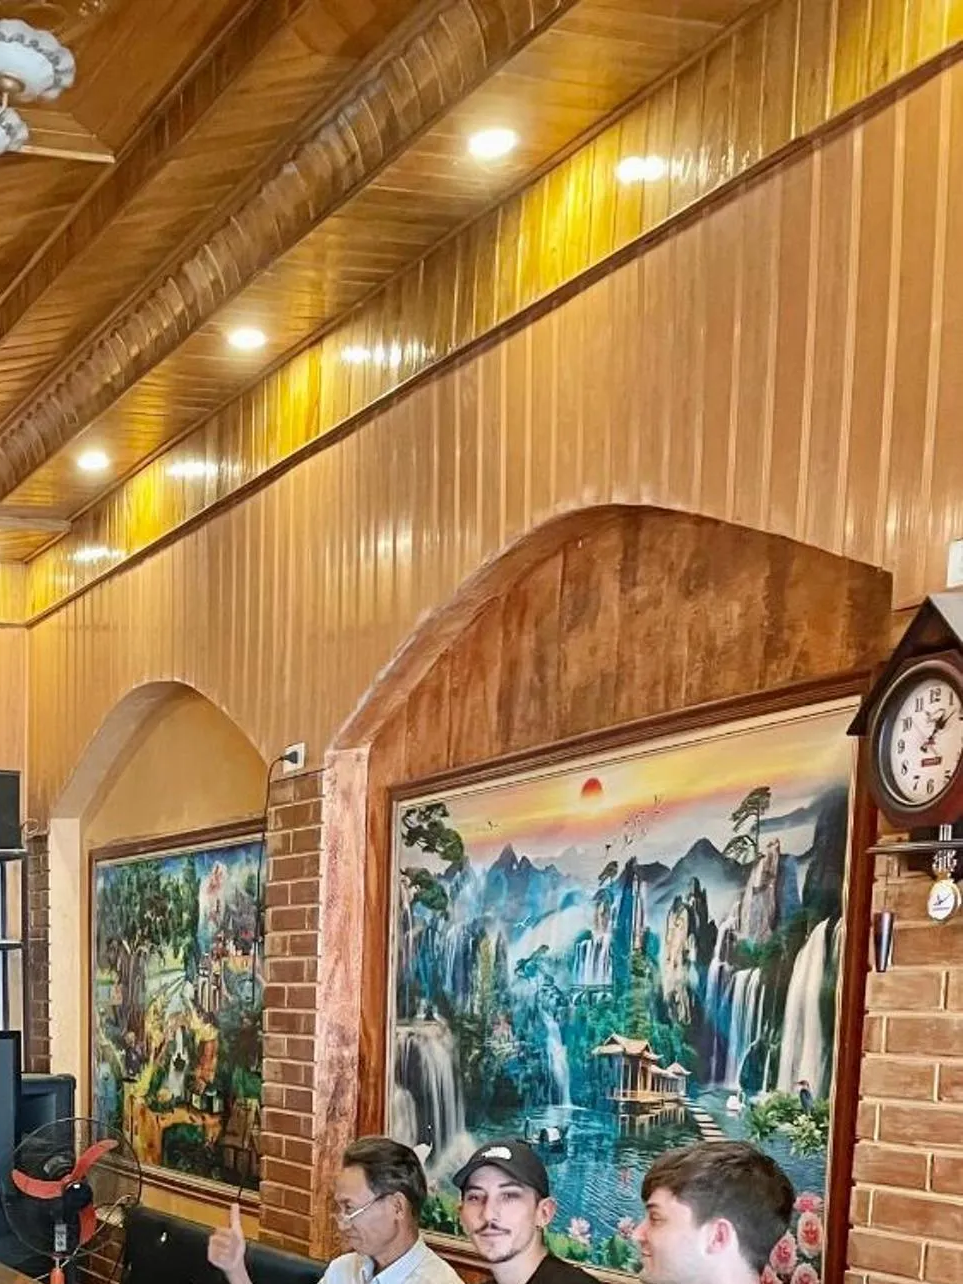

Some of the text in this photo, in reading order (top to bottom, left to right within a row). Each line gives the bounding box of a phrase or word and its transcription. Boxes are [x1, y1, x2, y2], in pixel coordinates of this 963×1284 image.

[929, 687, 941, 705] 12
[897, 739, 905, 754] 9
[926, 778, 934, 794] 6
